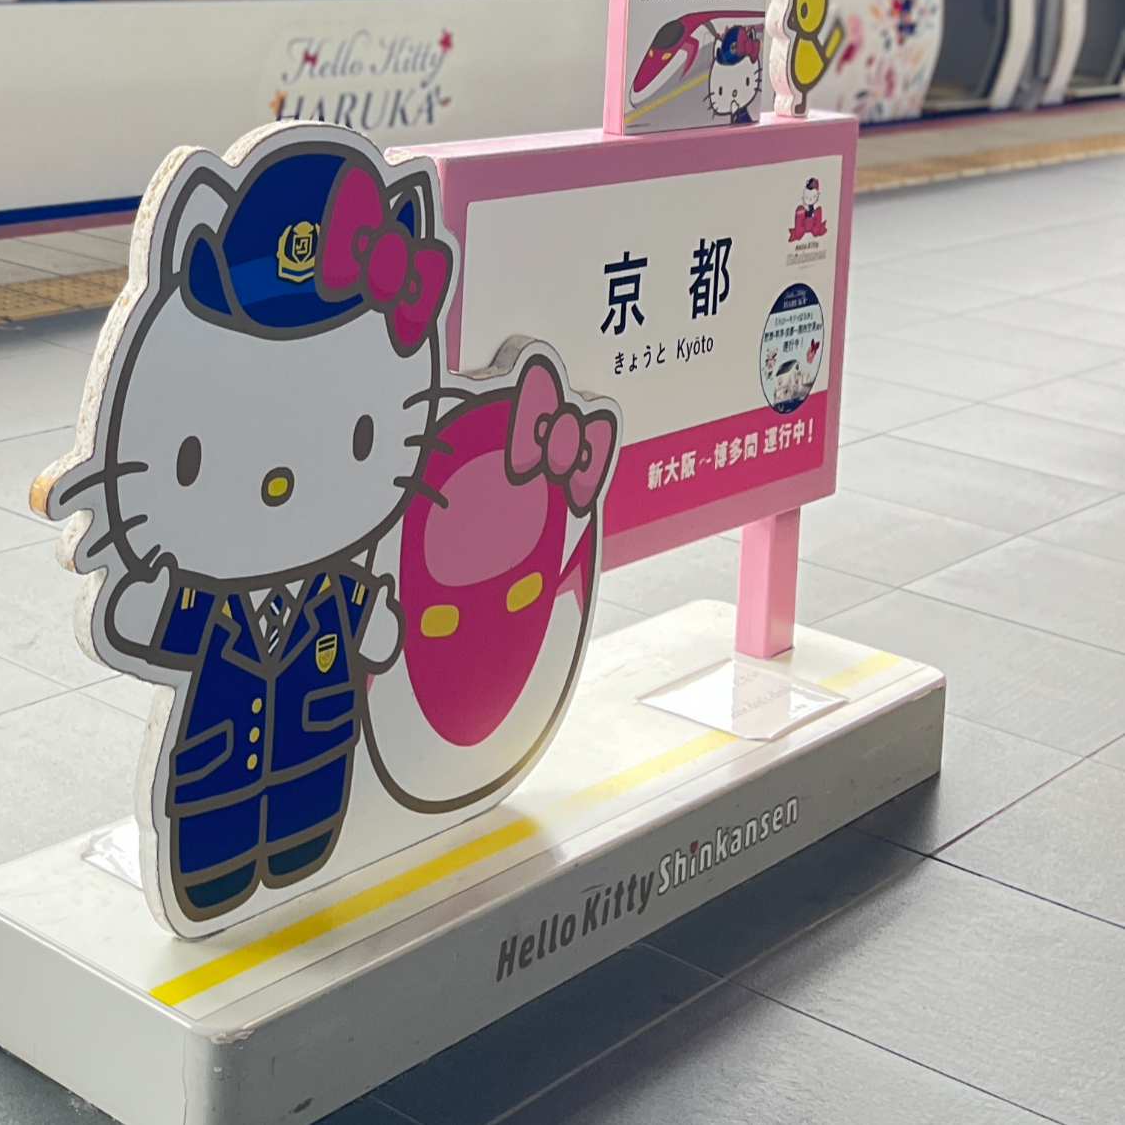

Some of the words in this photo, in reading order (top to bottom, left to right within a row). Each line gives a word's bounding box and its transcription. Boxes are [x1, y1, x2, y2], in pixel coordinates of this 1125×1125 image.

[280, 28, 371, 85] Hello
[370, 31, 448, 88] Kitty
[275, 86, 443, 130] HARUKA
[600, 237, 733, 336] 京都
[614, 342, 666, 375] きょうと
[676, 335, 714, 362] Kyōto
[496, 913, 576, 982] Hello
[581, 871, 655, 937] Kitty
[658, 796, 799, 895] Shinkansen
